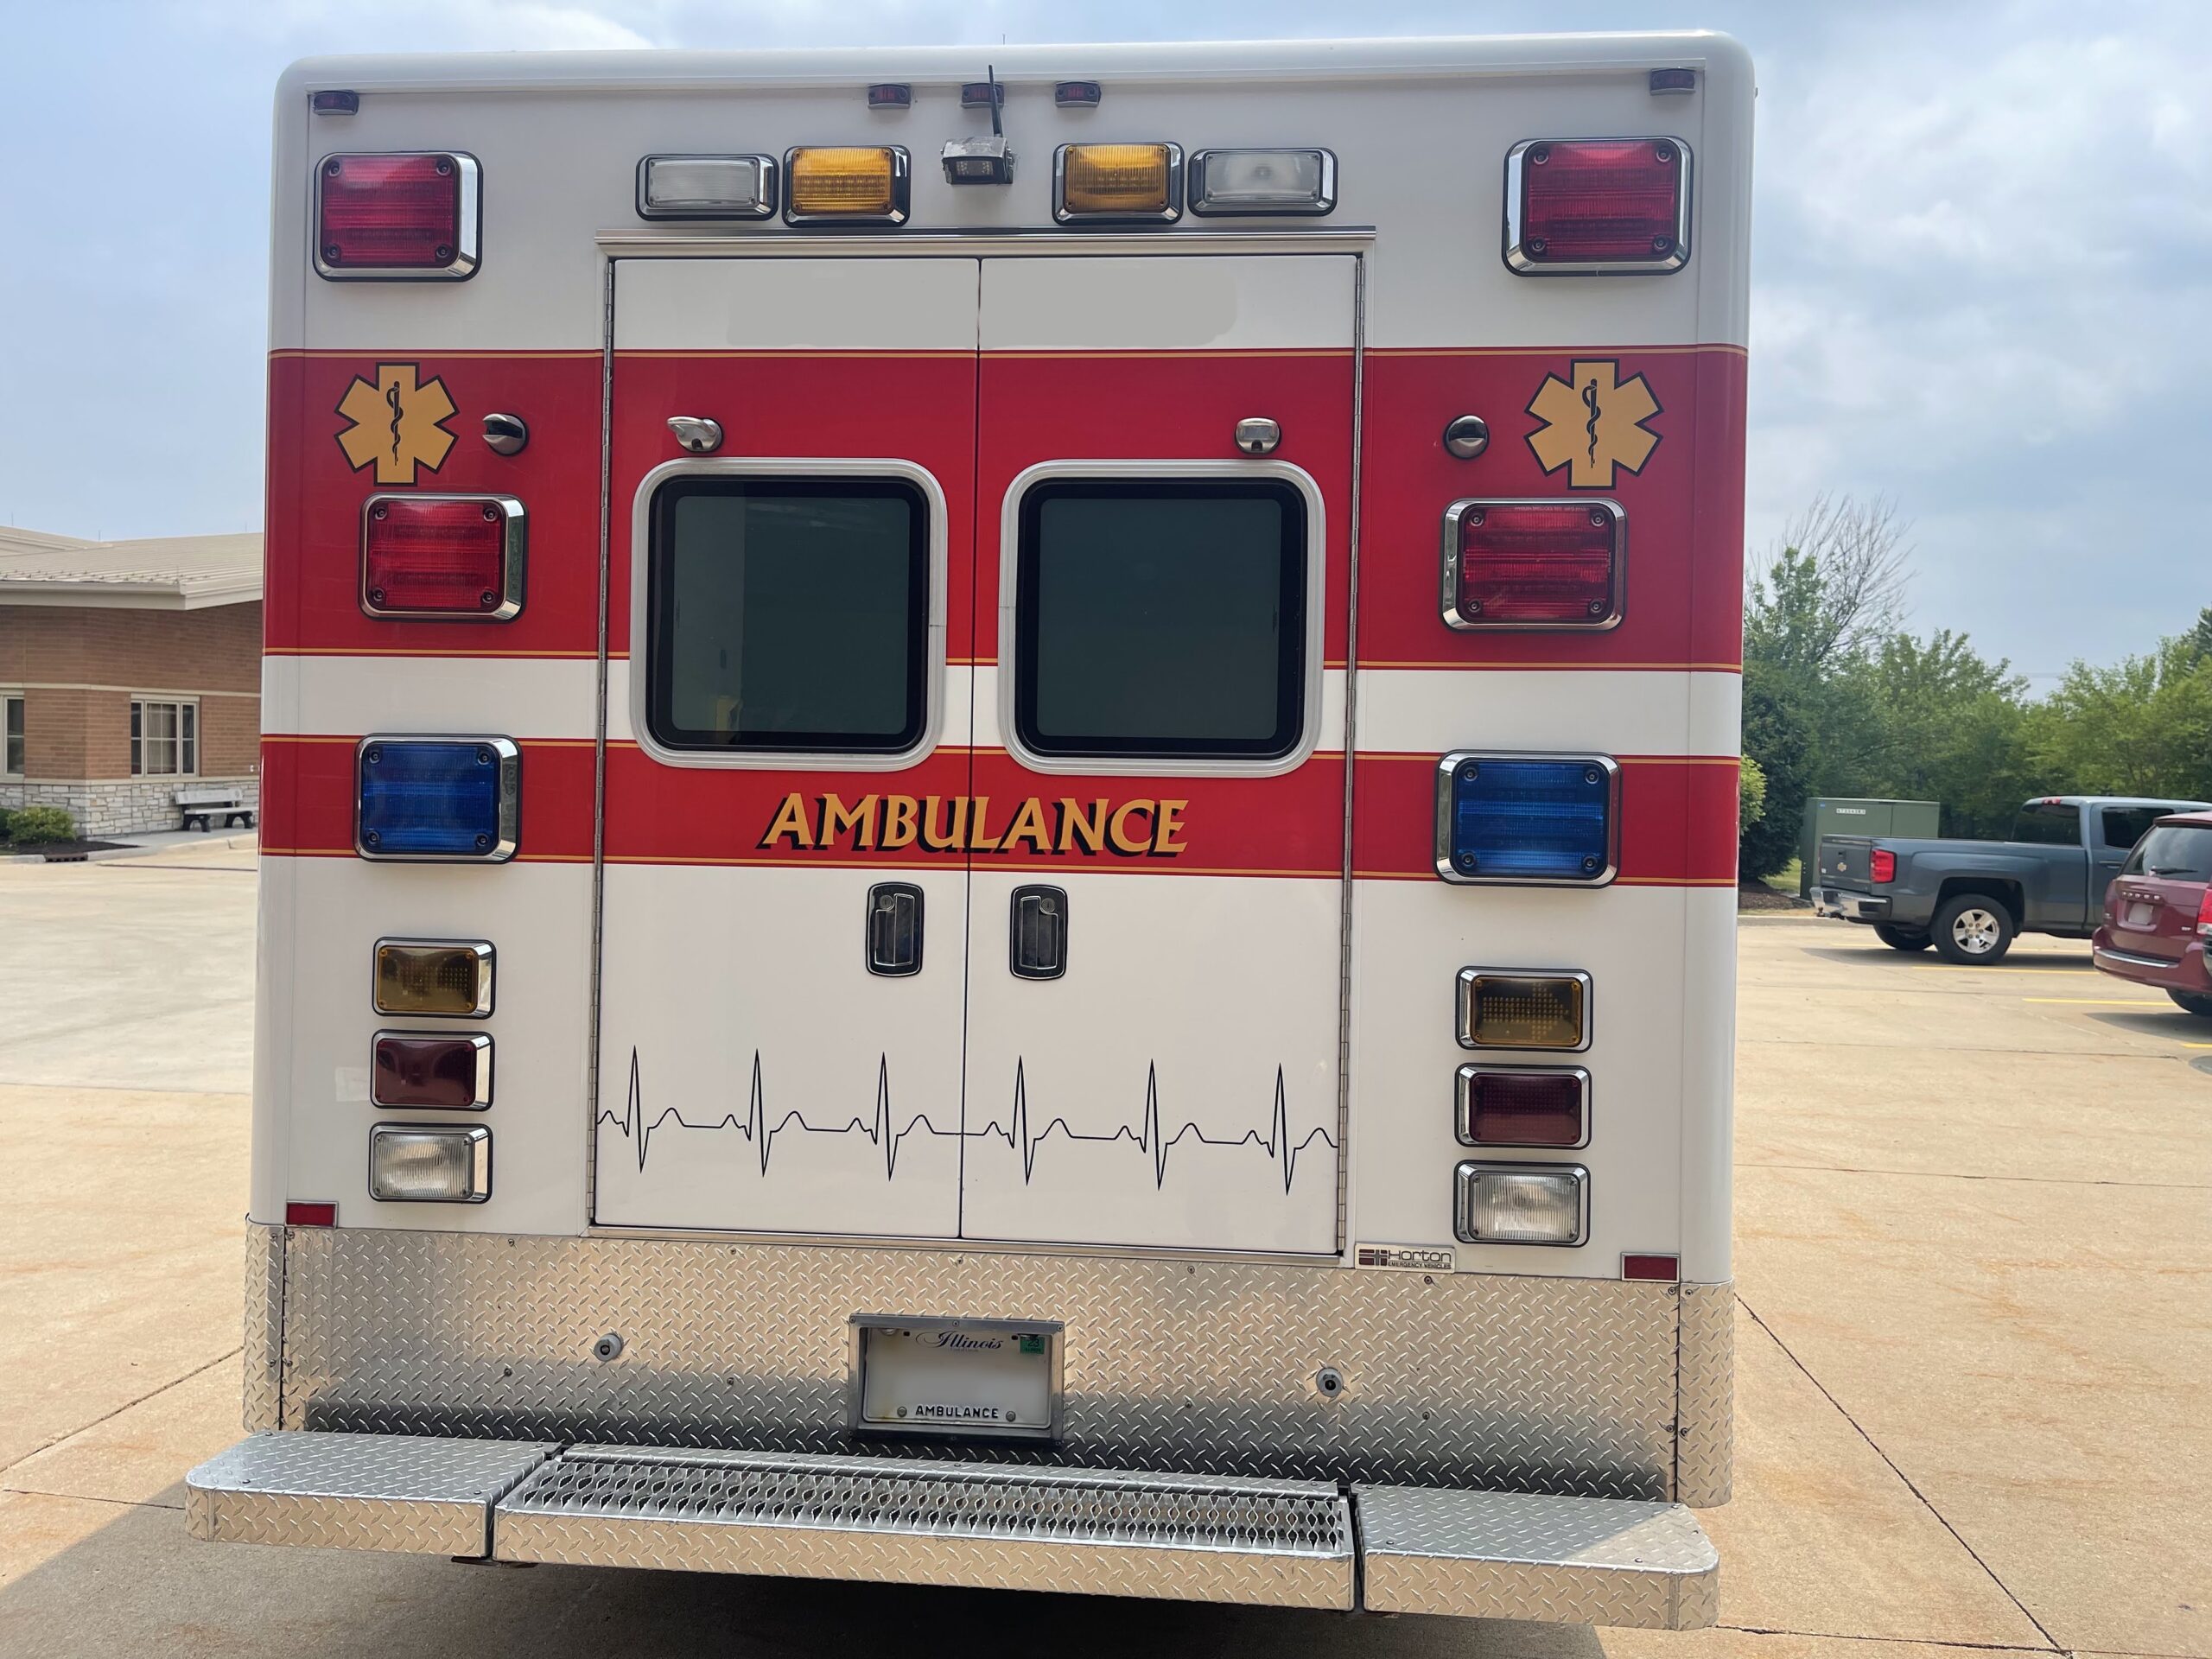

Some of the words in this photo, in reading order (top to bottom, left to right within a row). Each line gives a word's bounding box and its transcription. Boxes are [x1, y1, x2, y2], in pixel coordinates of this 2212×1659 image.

[755, 792, 1190, 857] AMBULANCE
[1388, 1249, 1452, 1262] Horton
[916, 1331, 1004, 1349] Illinois
[915, 1404, 1000, 1419] AMBULANCE
